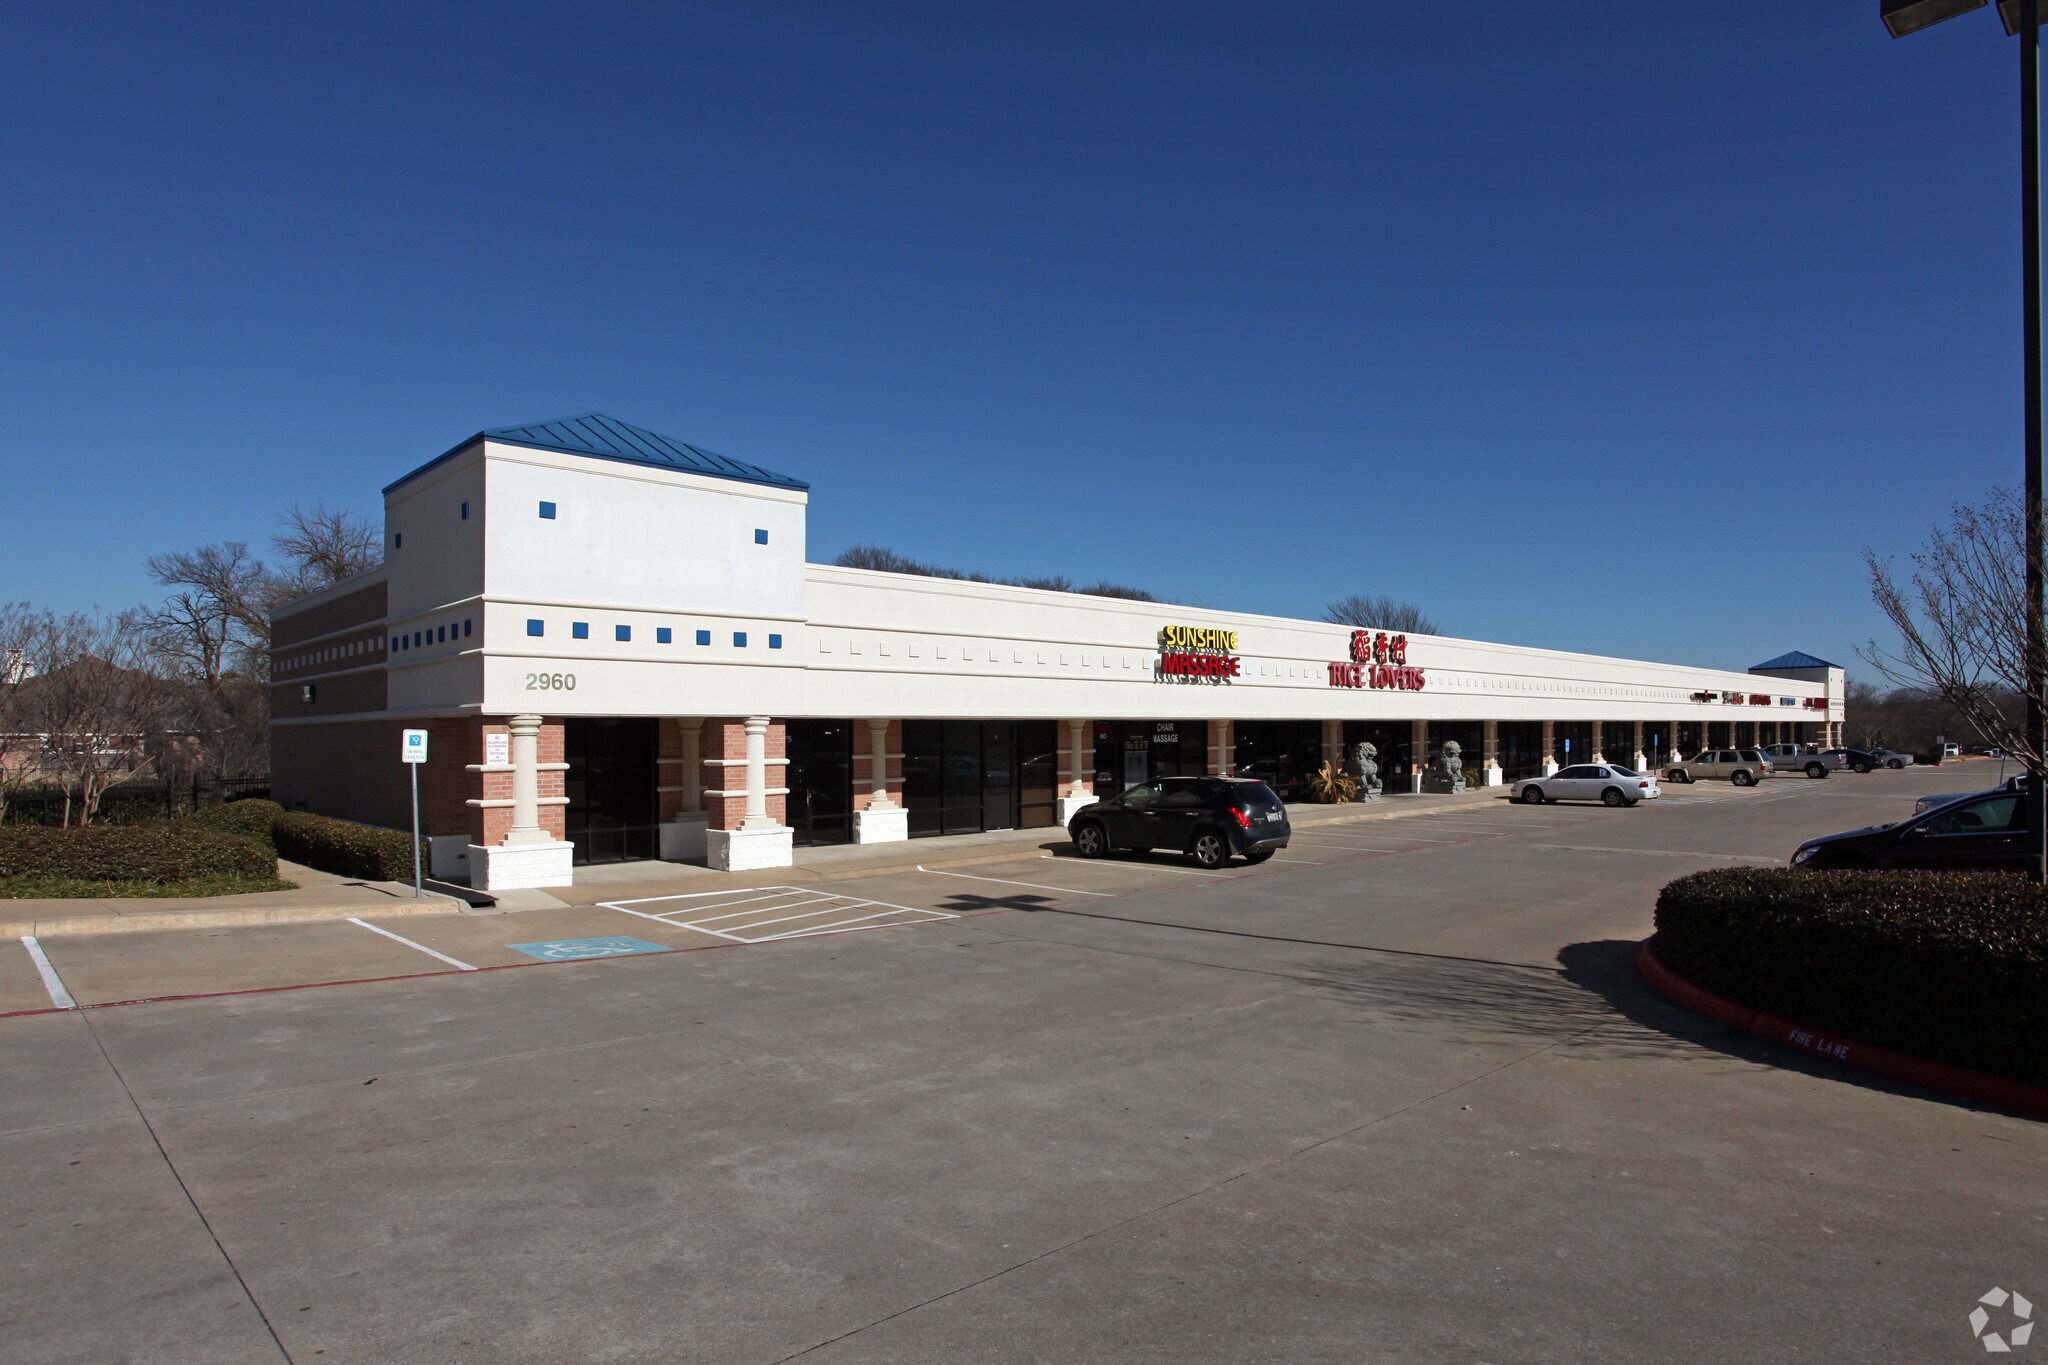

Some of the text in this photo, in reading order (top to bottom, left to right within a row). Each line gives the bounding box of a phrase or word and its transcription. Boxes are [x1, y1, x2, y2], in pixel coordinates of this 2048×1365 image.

[1164, 625, 1239, 650] SUNSHINE
[1162, 651, 1241, 678] MASSAGE
[1328, 661, 1426, 691] RICE LOVERS
[525, 672, 577, 691] 2960
[1156, 723, 1174, 732] CHAIR
[1788, 1029, 1850, 1059] FIRE LANE
